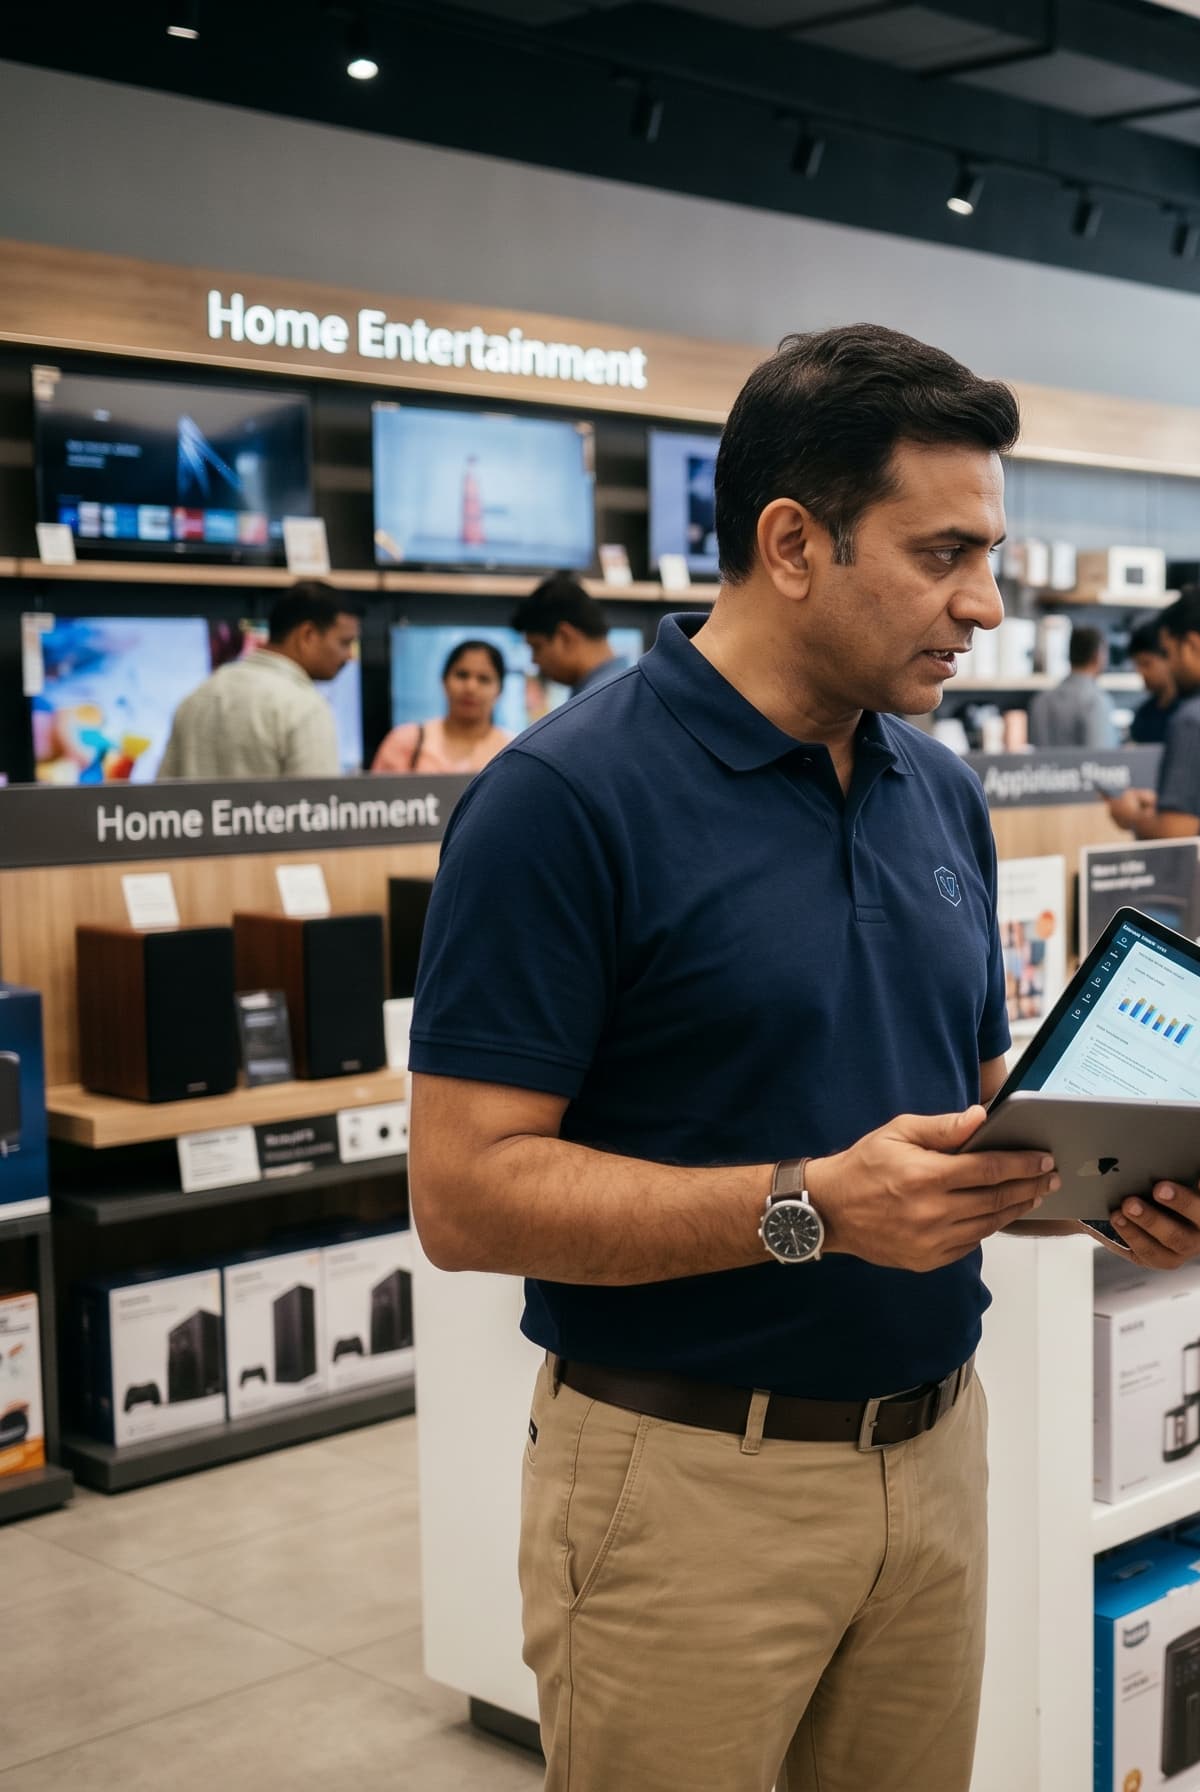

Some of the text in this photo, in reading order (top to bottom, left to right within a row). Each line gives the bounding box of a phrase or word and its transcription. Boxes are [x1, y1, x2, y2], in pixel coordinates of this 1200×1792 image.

[208, 290, 648, 389] Home Entertainment
[97, 793, 440, 842] Home Entertainment
